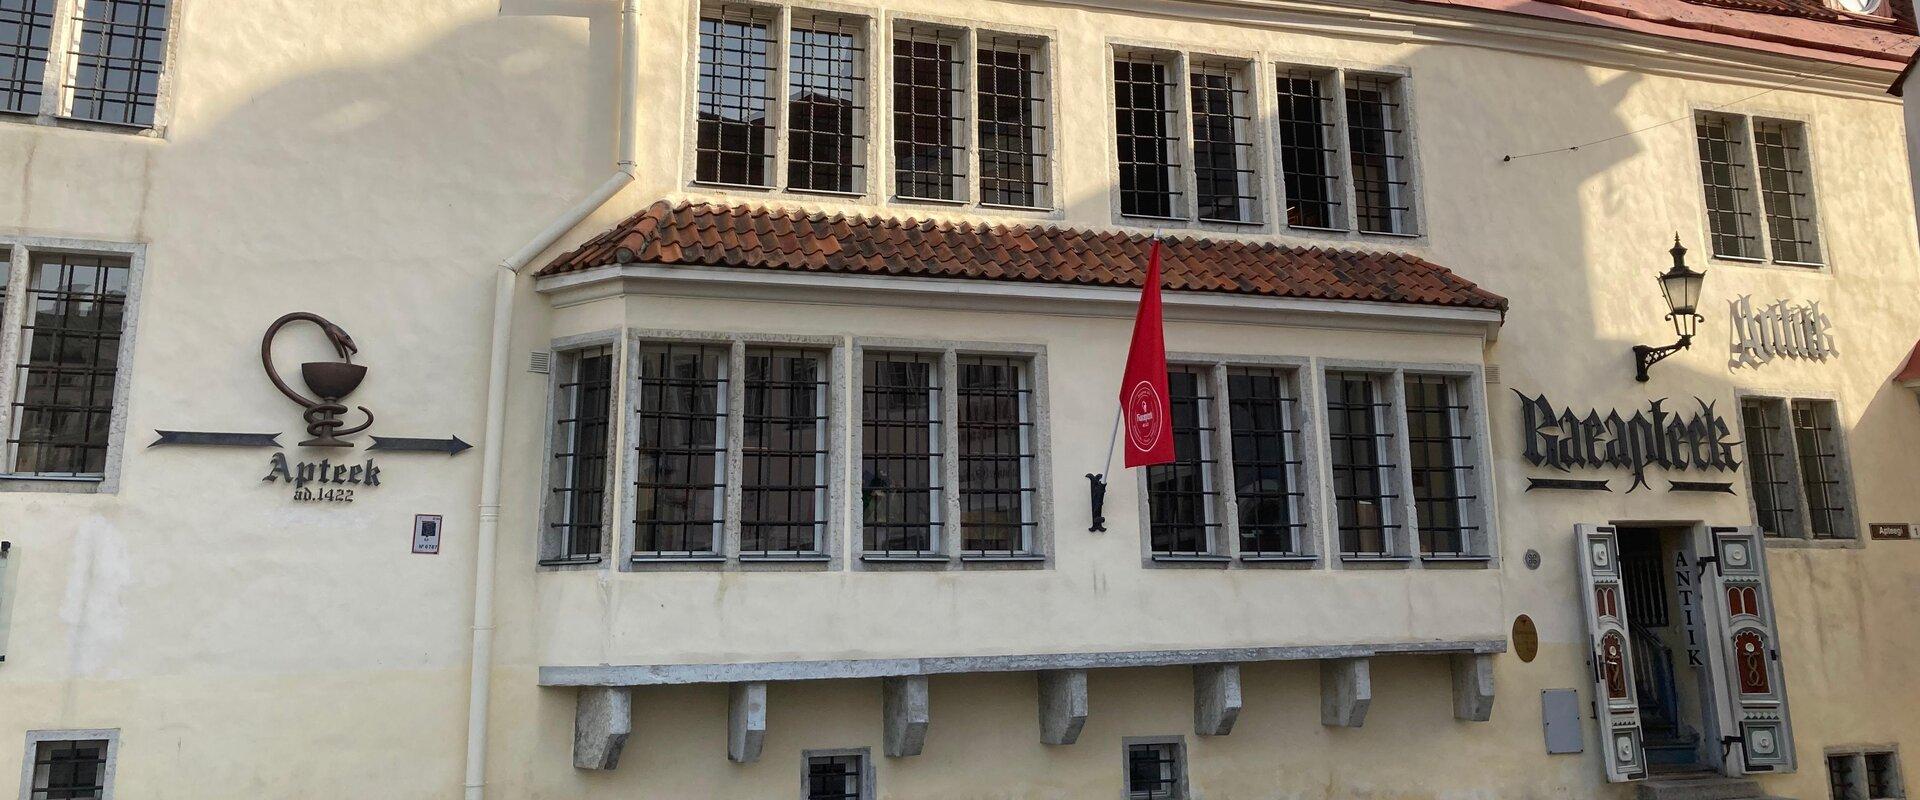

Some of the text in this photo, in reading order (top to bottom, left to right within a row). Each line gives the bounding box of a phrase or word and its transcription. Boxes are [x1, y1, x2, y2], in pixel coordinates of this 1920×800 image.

[262, 452, 380, 488] Apteek
[1510, 387, 1744, 494] Raeapteek
[1675, 551, 1703, 666] ANTIK
